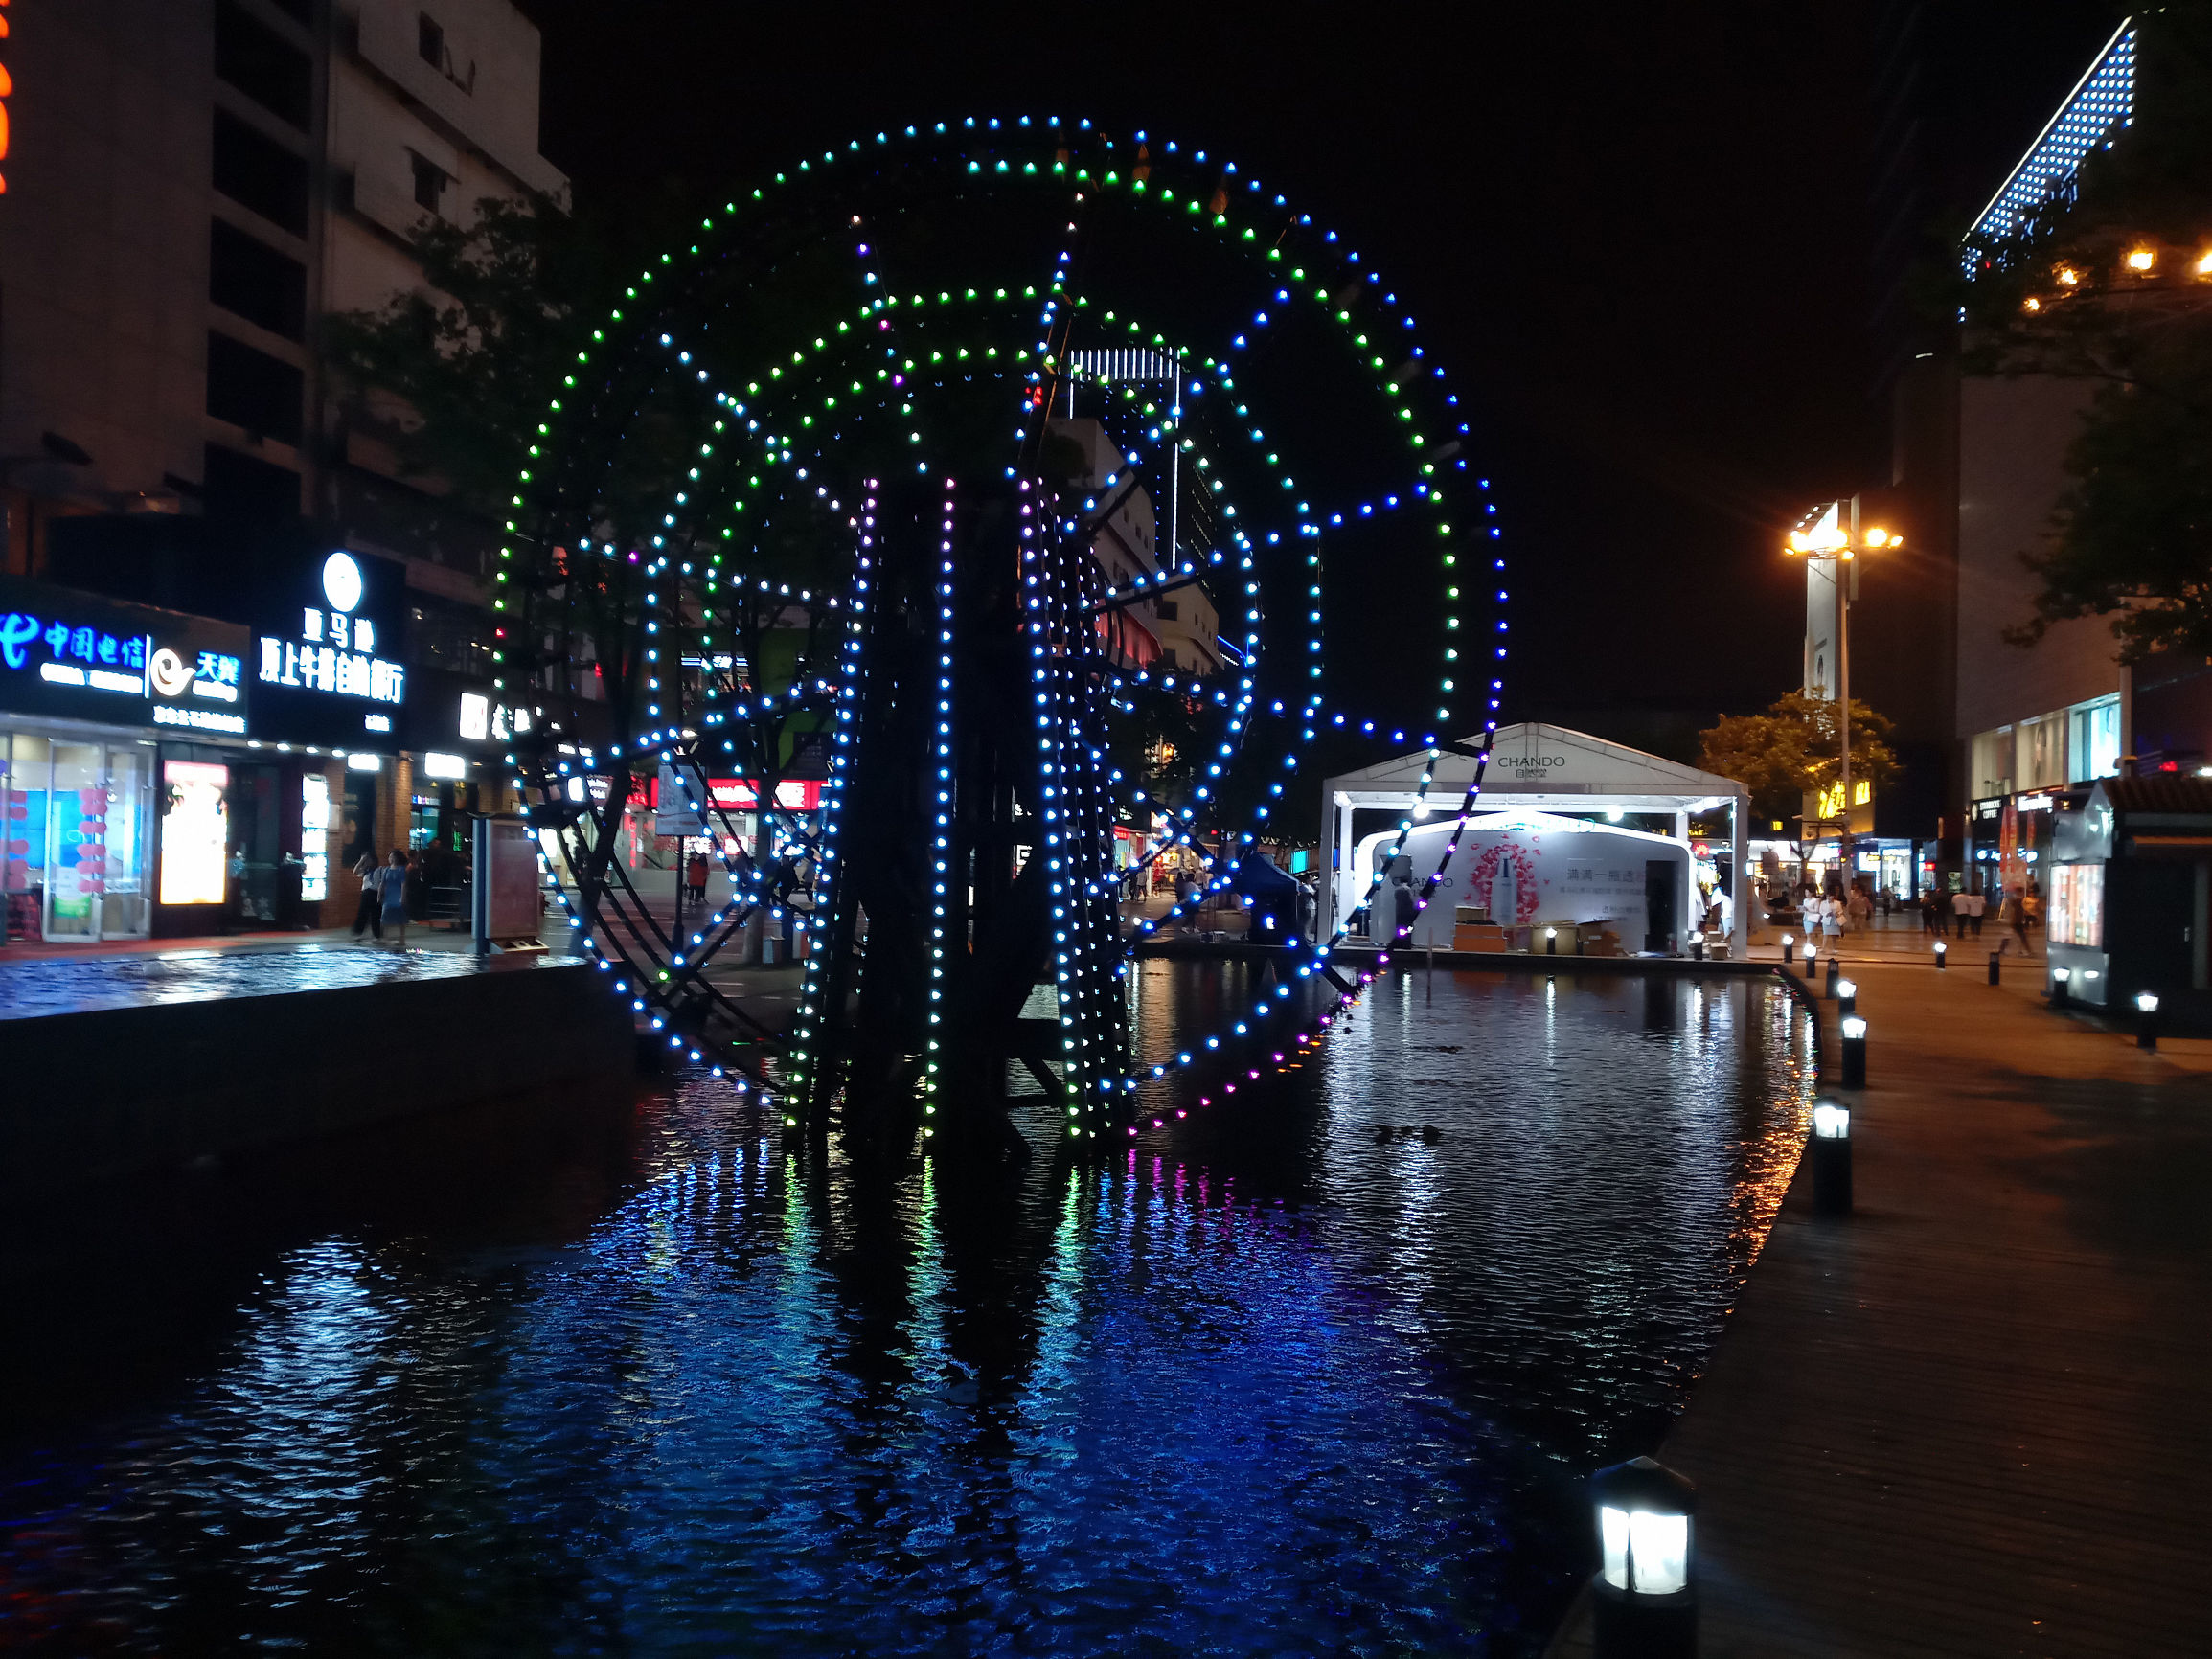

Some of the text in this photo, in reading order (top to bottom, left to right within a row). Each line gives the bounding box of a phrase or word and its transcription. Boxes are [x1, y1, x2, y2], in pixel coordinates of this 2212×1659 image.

[44, 621, 144, 669] 中国电信
[195, 651, 239, 685] 天翼
[1497, 756, 1565, 767] CHANDO
[1979, 799, 2002, 811] STARBUCKS
